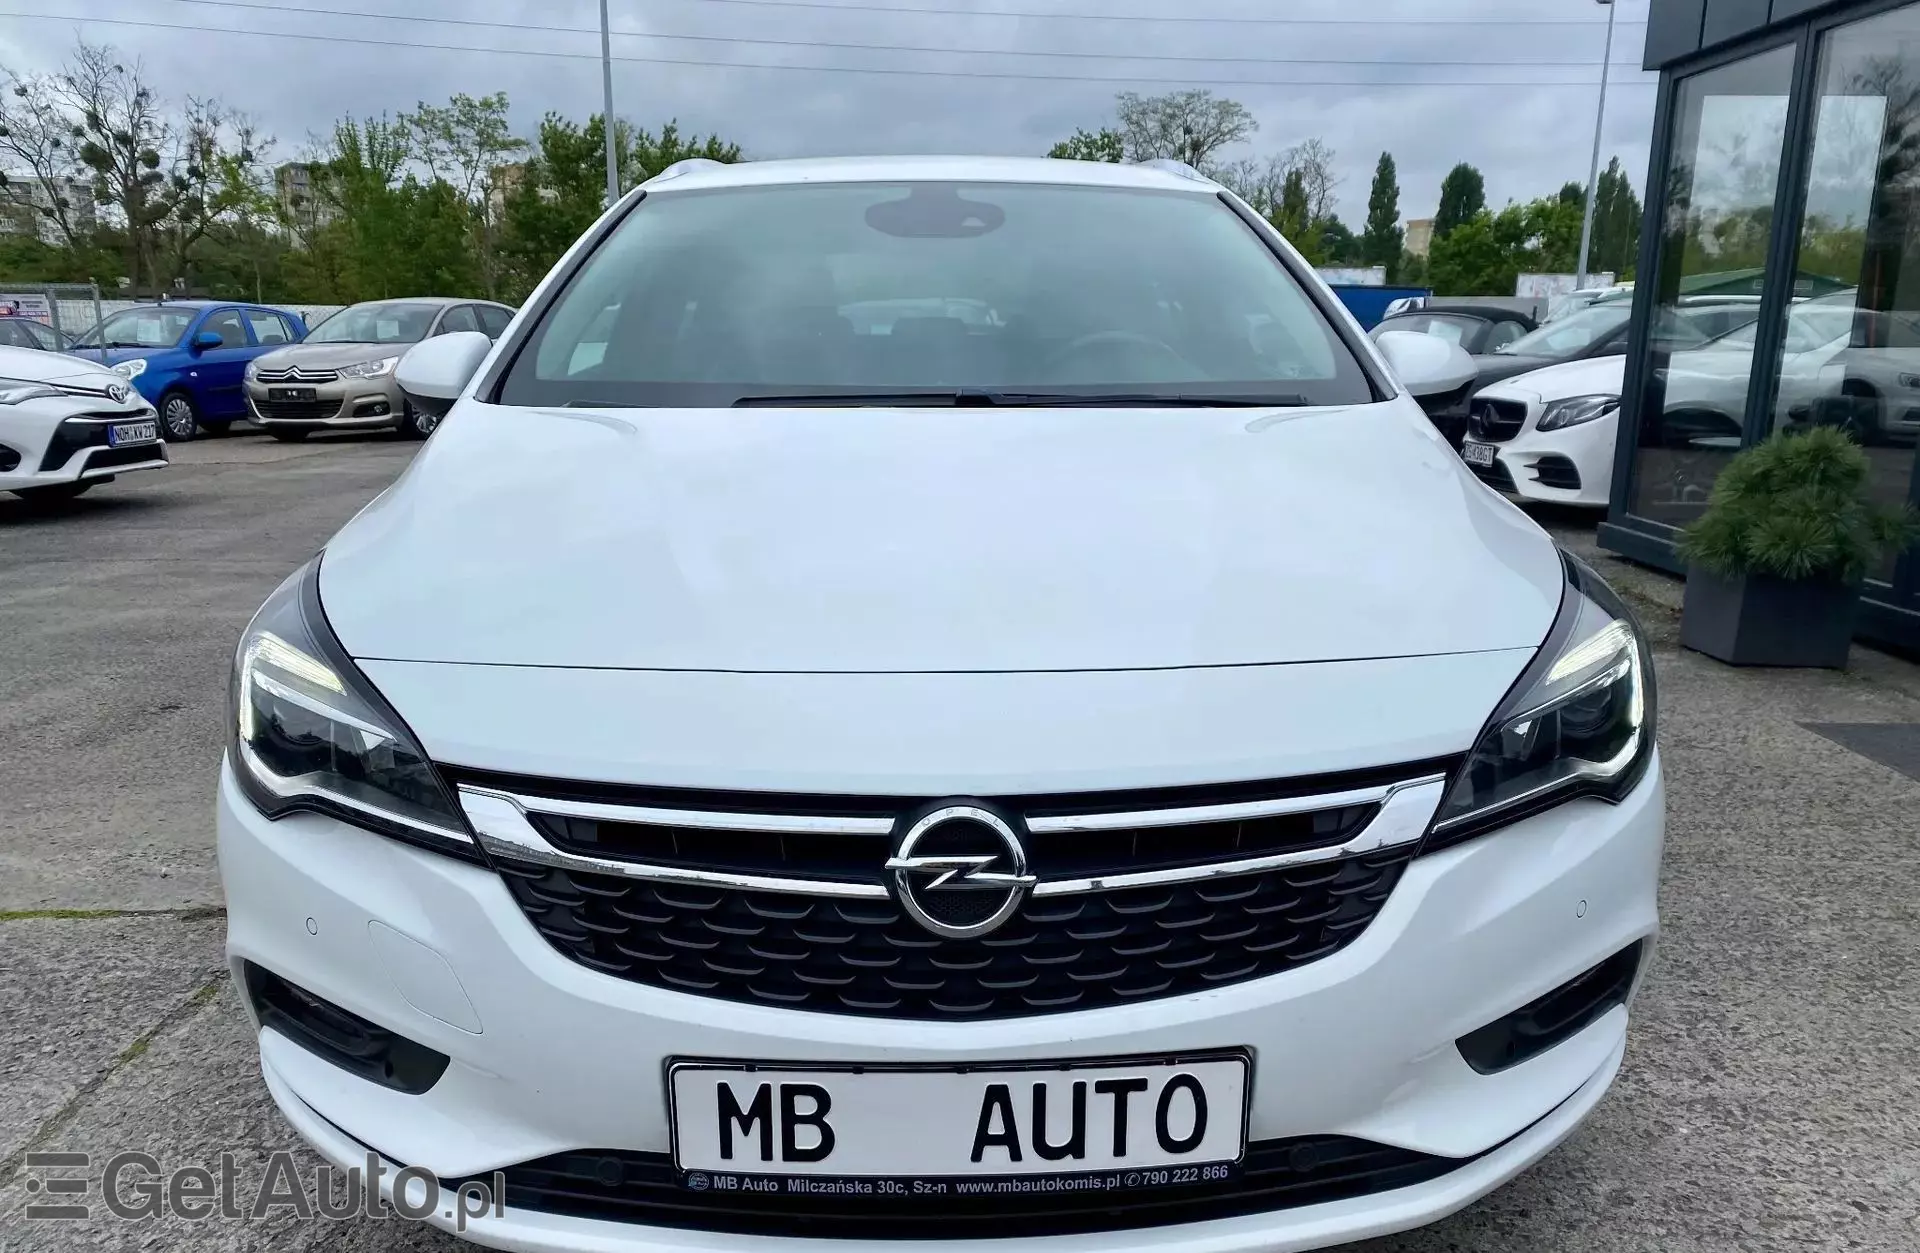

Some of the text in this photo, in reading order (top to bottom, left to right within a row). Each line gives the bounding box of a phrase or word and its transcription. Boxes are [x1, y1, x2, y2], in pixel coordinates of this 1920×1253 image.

[921, 808, 999, 828] OPEL
[717, 1073, 1208, 1162] MB AUTO
[713, 1176, 738, 1190] MB
[742, 1178, 778, 1192] Auto
[787, 1179, 873, 1194] Milczańska
[877, 1180, 908, 1196] 30c,
[913, 1181, 947, 1194] Sz-n
[956, 1174, 1121, 1194] www.mbautokomis.pl
[1142, 1171, 1168, 1185] 790
[1172, 1168, 1198, 1183] 222
[1202, 1165, 1228, 1180] 866
